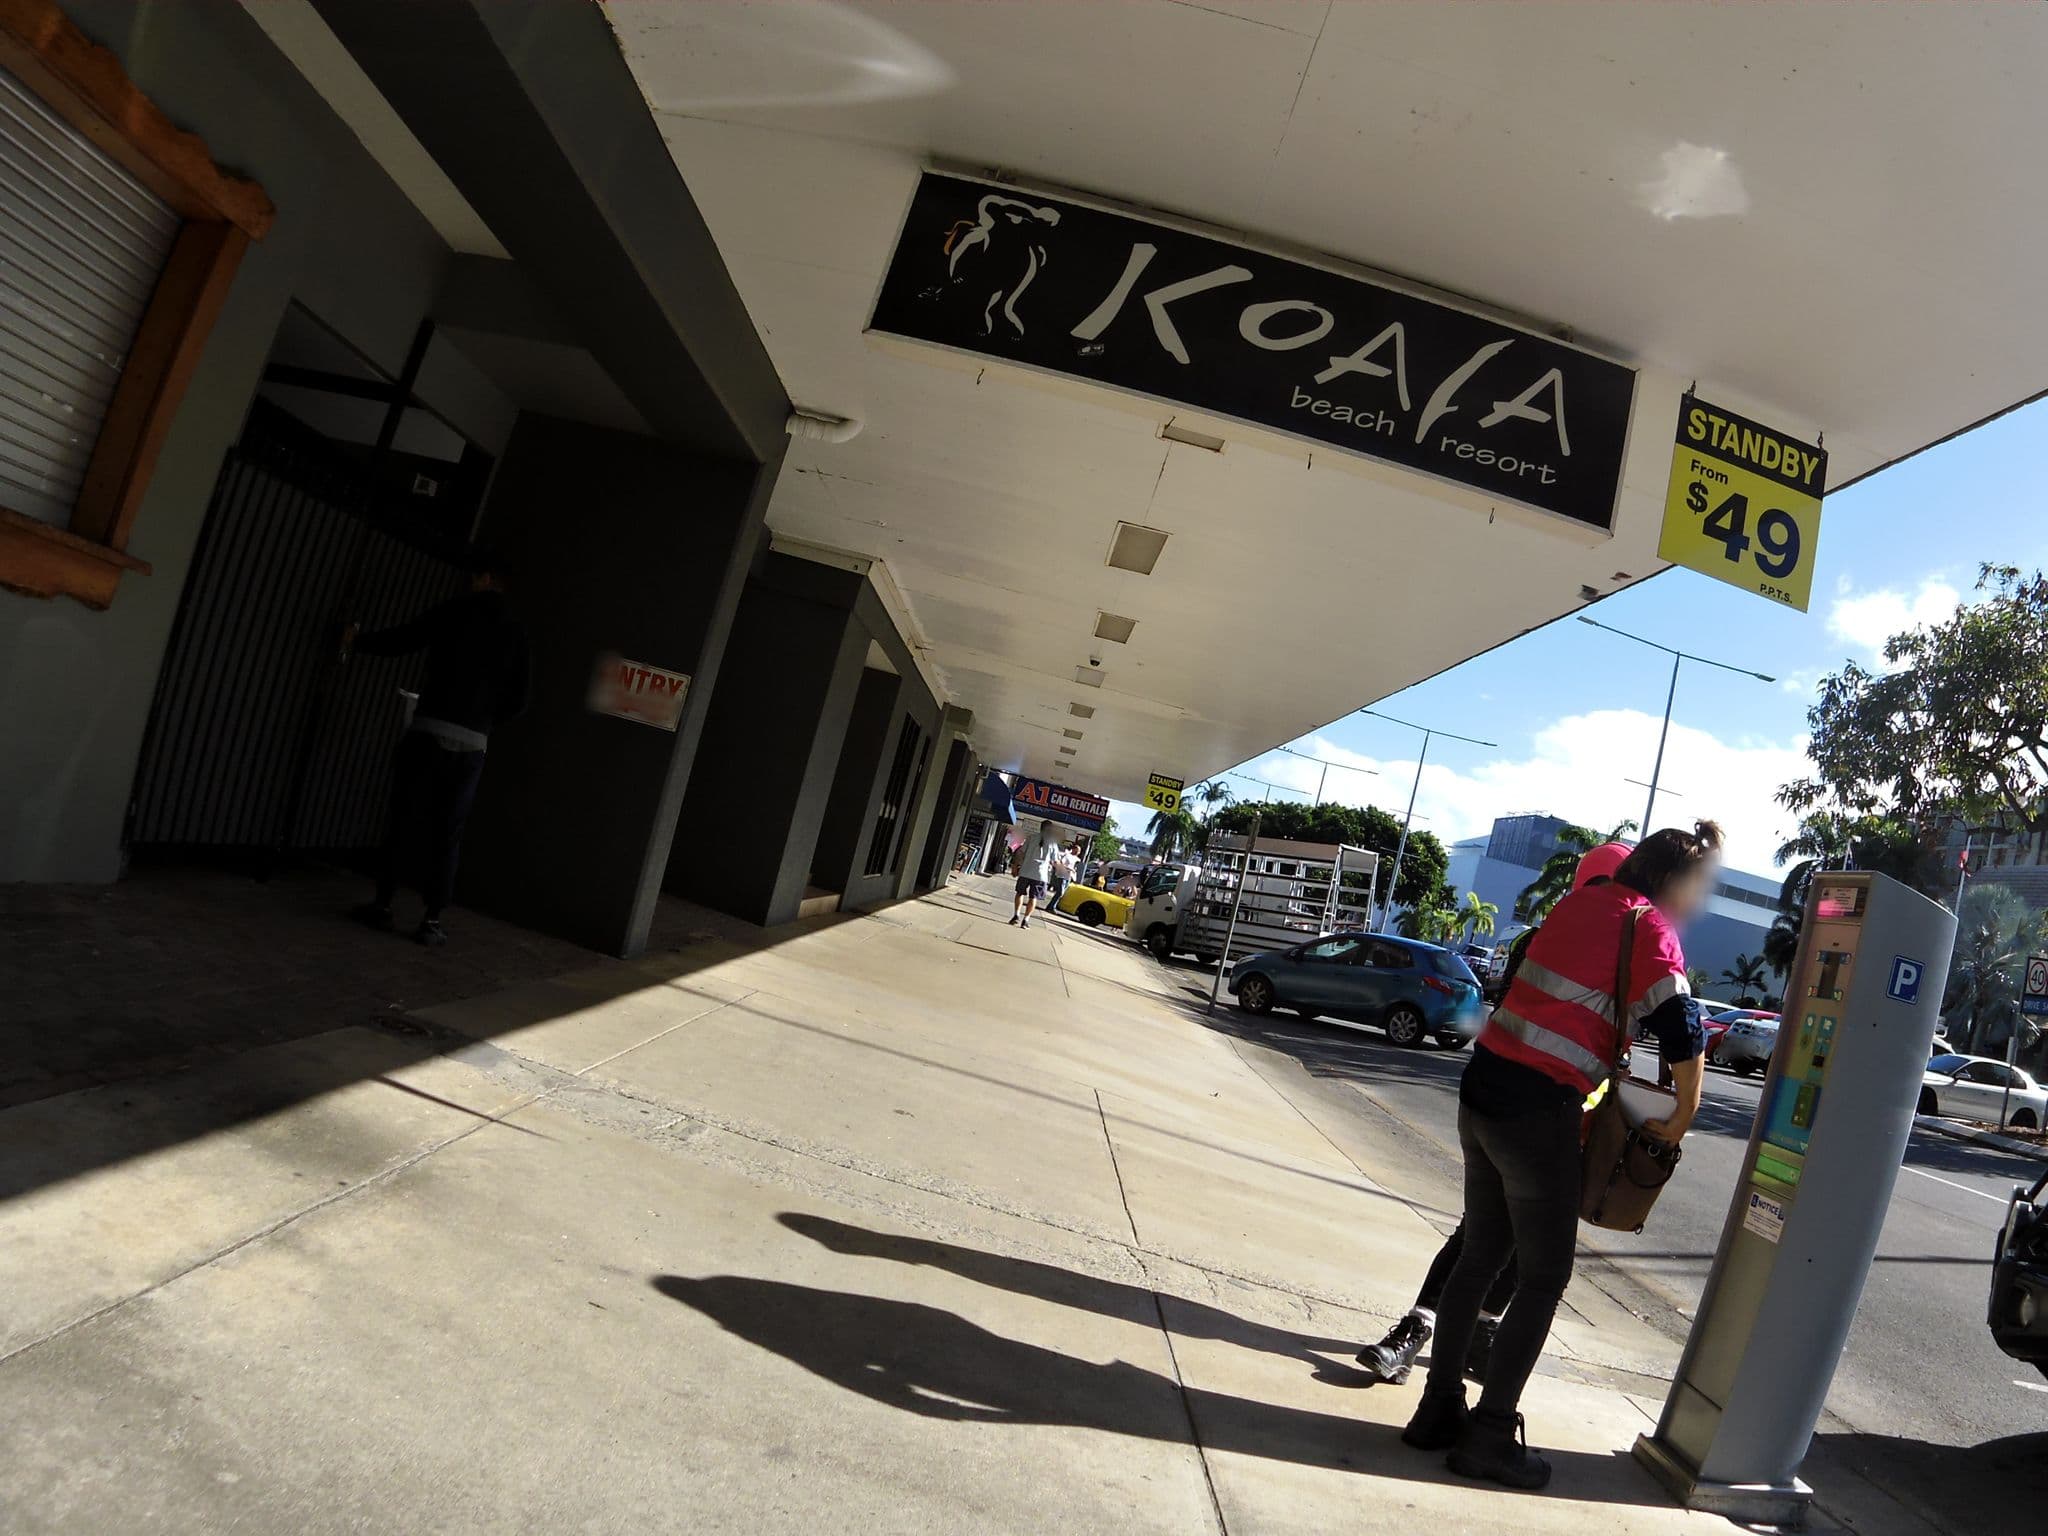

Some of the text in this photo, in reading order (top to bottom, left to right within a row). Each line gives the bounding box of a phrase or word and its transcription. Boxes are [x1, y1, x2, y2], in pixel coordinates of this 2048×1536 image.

[1291, 385, 1556, 484] beach resort
[1687, 408, 1819, 485] STANDBY
[1690, 459, 1728, 485] From
[1686, 480, 1800, 579] $49
[1760, 583, 1793, 603] P.P.T.S.
[604, 663, 684, 698] NTRY
[1015, 781, 1050, 807] A1
[1050, 793, 1068, 807] CAR
[1069, 798, 1107, 816] RENTALS
[1151, 775, 1183, 790] STANDBY
[1894, 962, 1917, 995] P
[2031, 969, 2045, 985] 40
[1758, 1200, 1779, 1216] NOTICE
